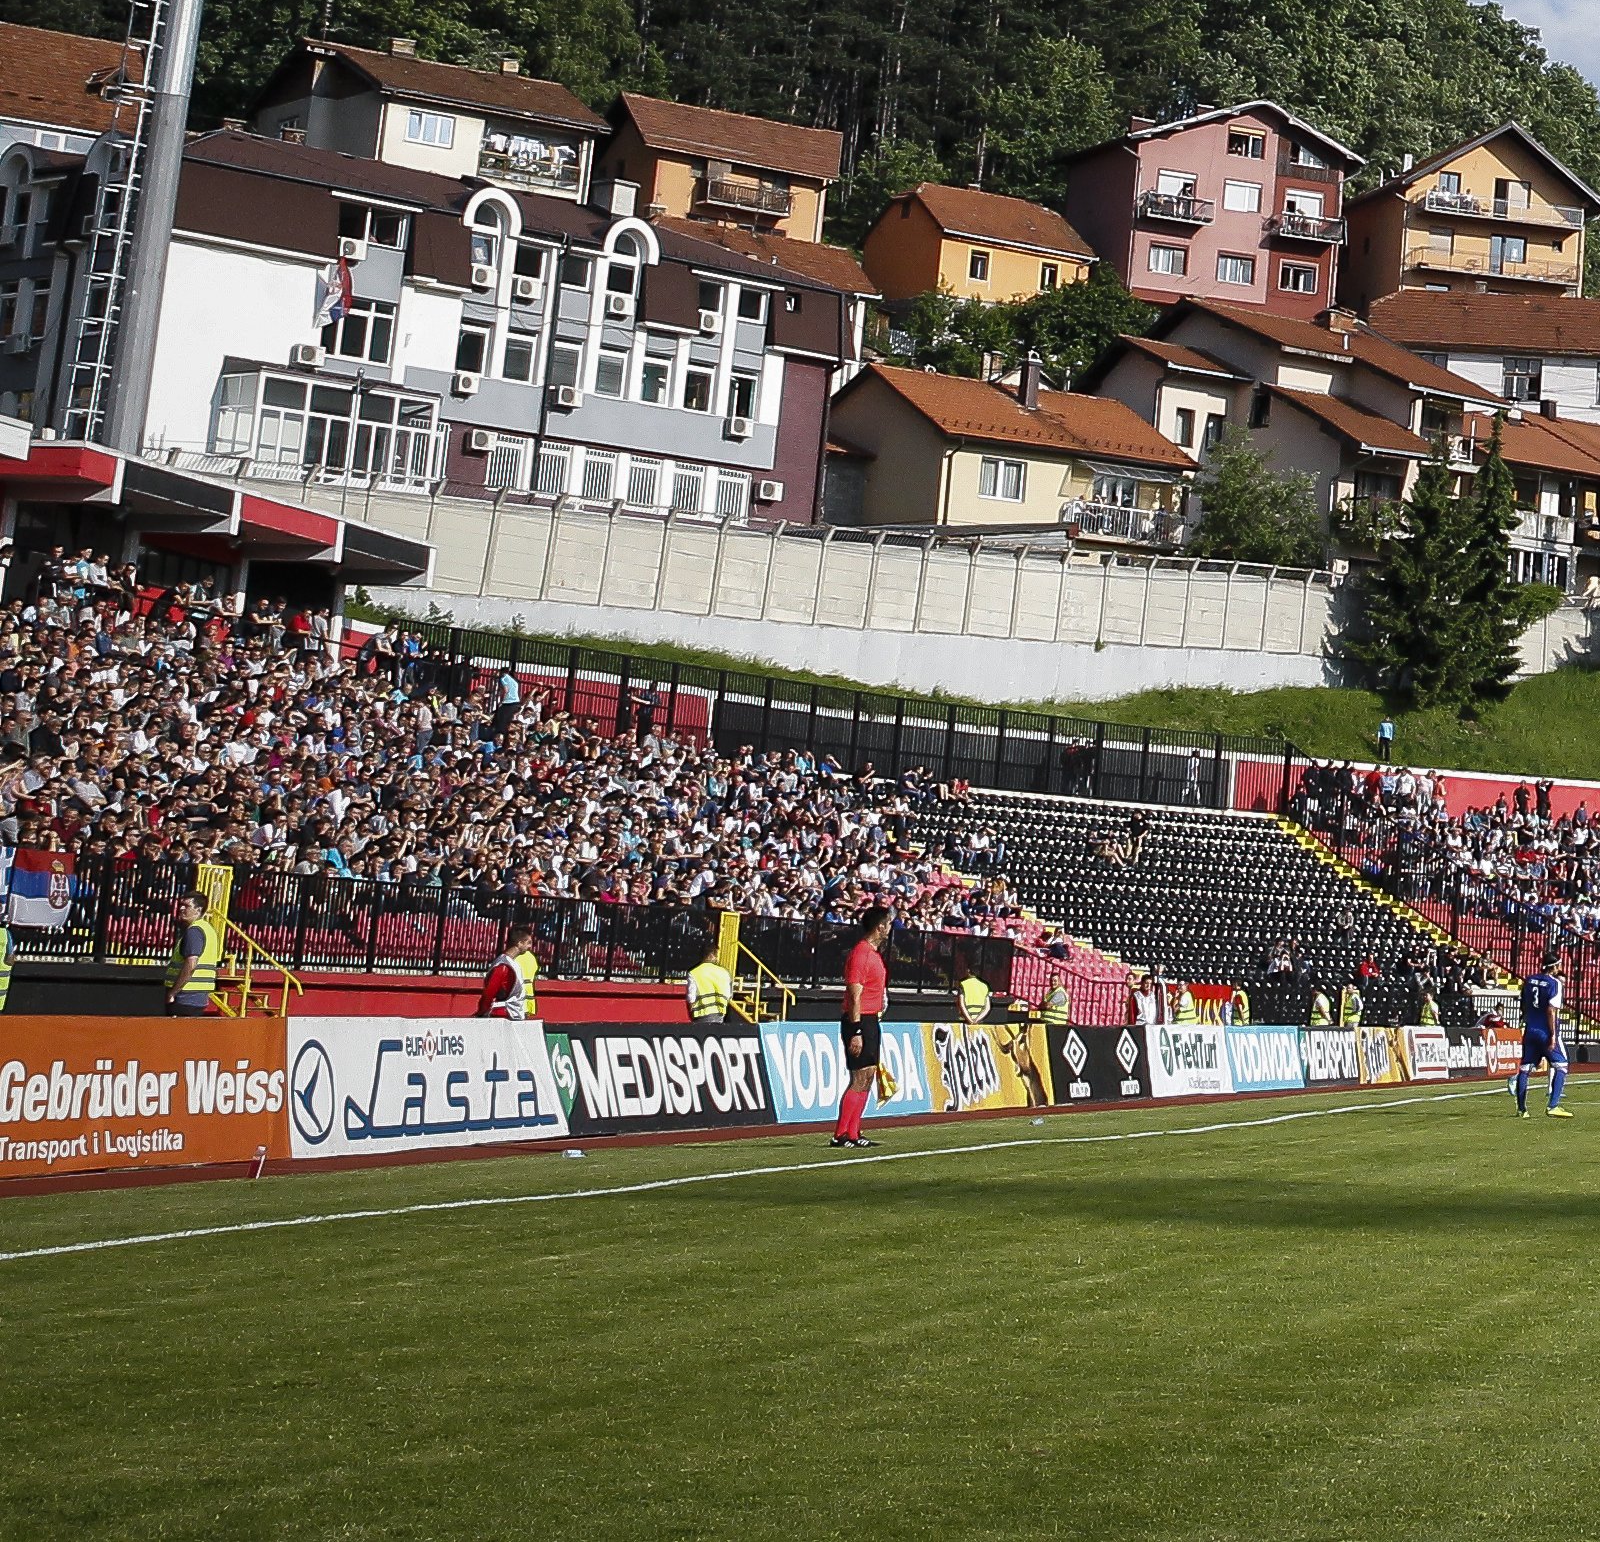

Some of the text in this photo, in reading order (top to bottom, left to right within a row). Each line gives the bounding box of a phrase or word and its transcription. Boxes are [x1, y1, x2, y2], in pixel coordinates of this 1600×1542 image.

[570, 1036, 766, 1118] MEDISPORT
[1228, 1032, 1298, 1082] VODAVODA
[0, 1059, 285, 1122] Gebrüder Weiss
[93, 1132, 99, 1155] i
[104, 1128, 183, 1158] Logistika
